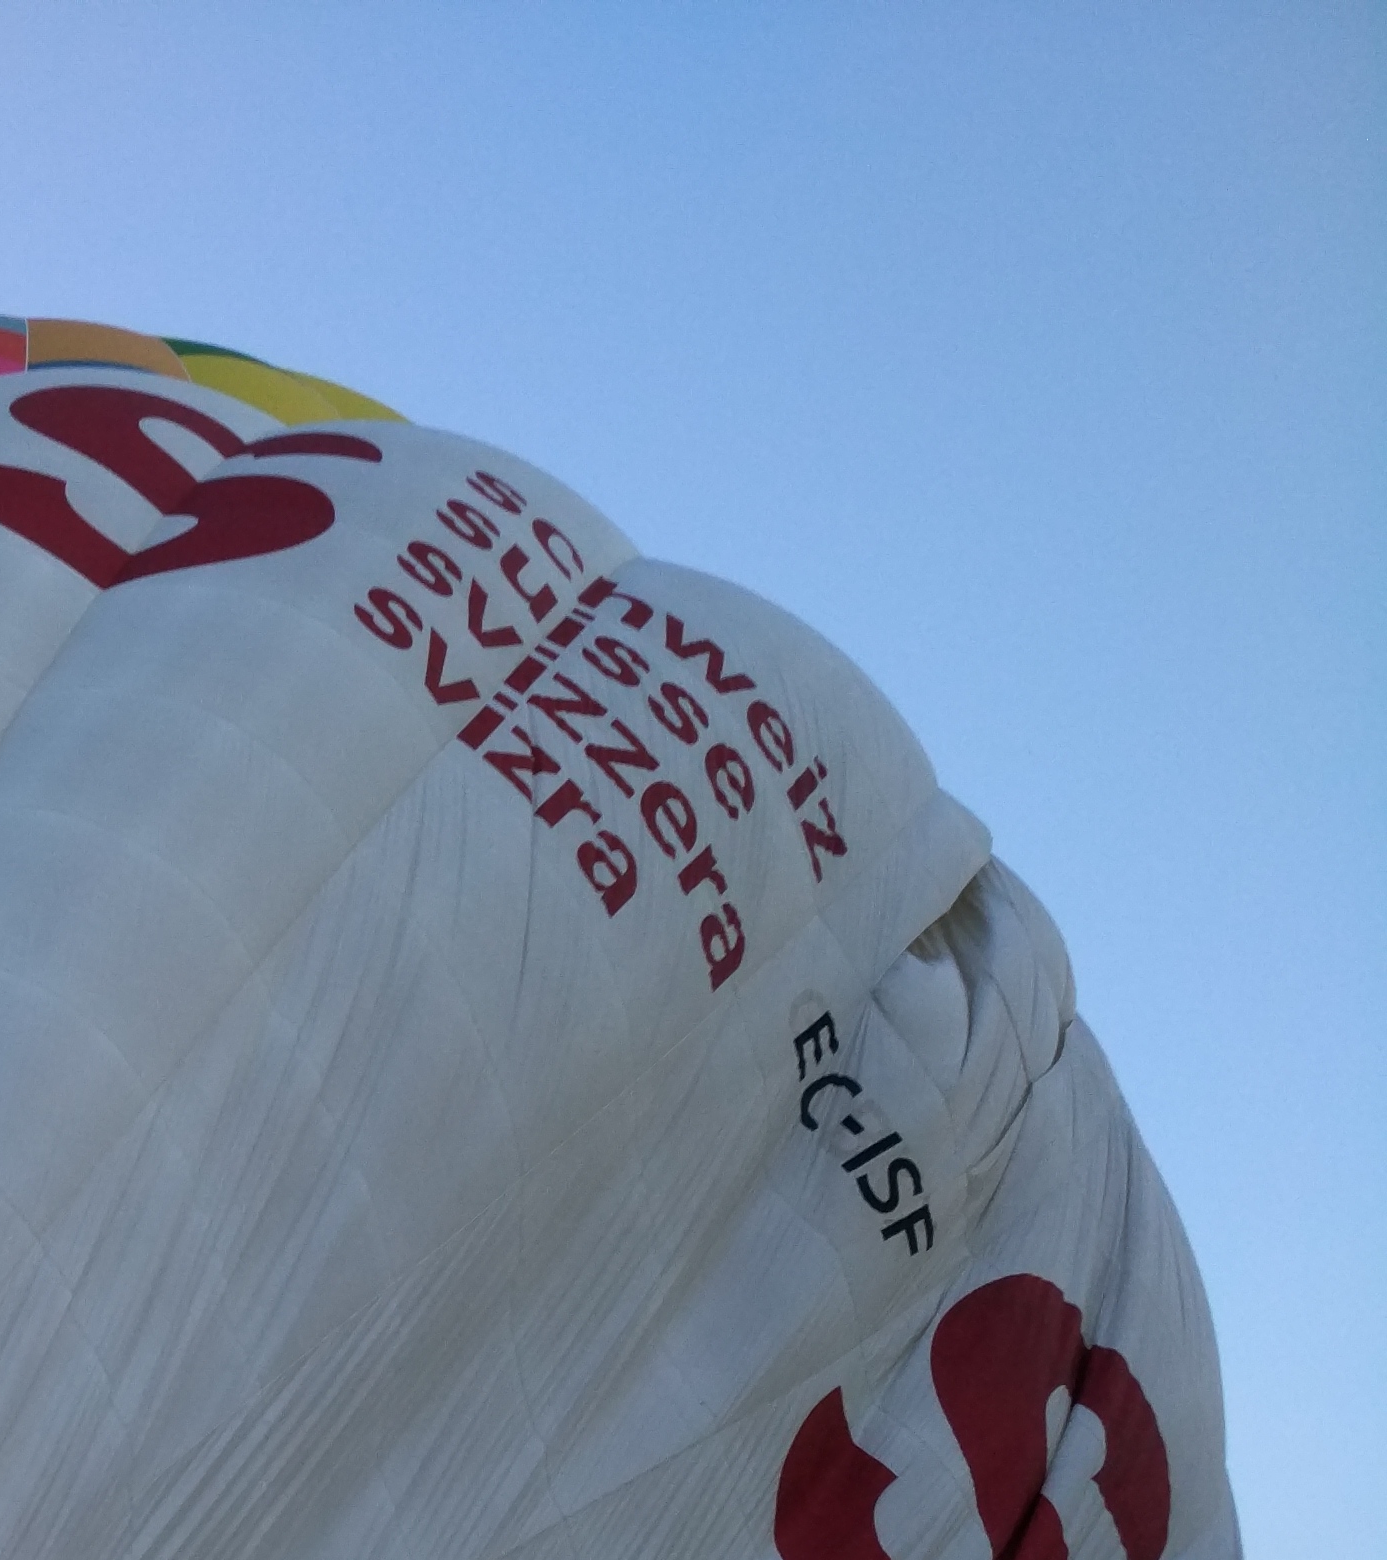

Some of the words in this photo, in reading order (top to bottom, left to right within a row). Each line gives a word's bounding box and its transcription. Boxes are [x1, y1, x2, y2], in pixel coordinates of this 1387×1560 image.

[354, 585, 638, 917] svizra
[397, 540, 747, 992] svizzera
[435, 498, 754, 821] suisse
[793, 1010, 935, 1258] EC-ISF
